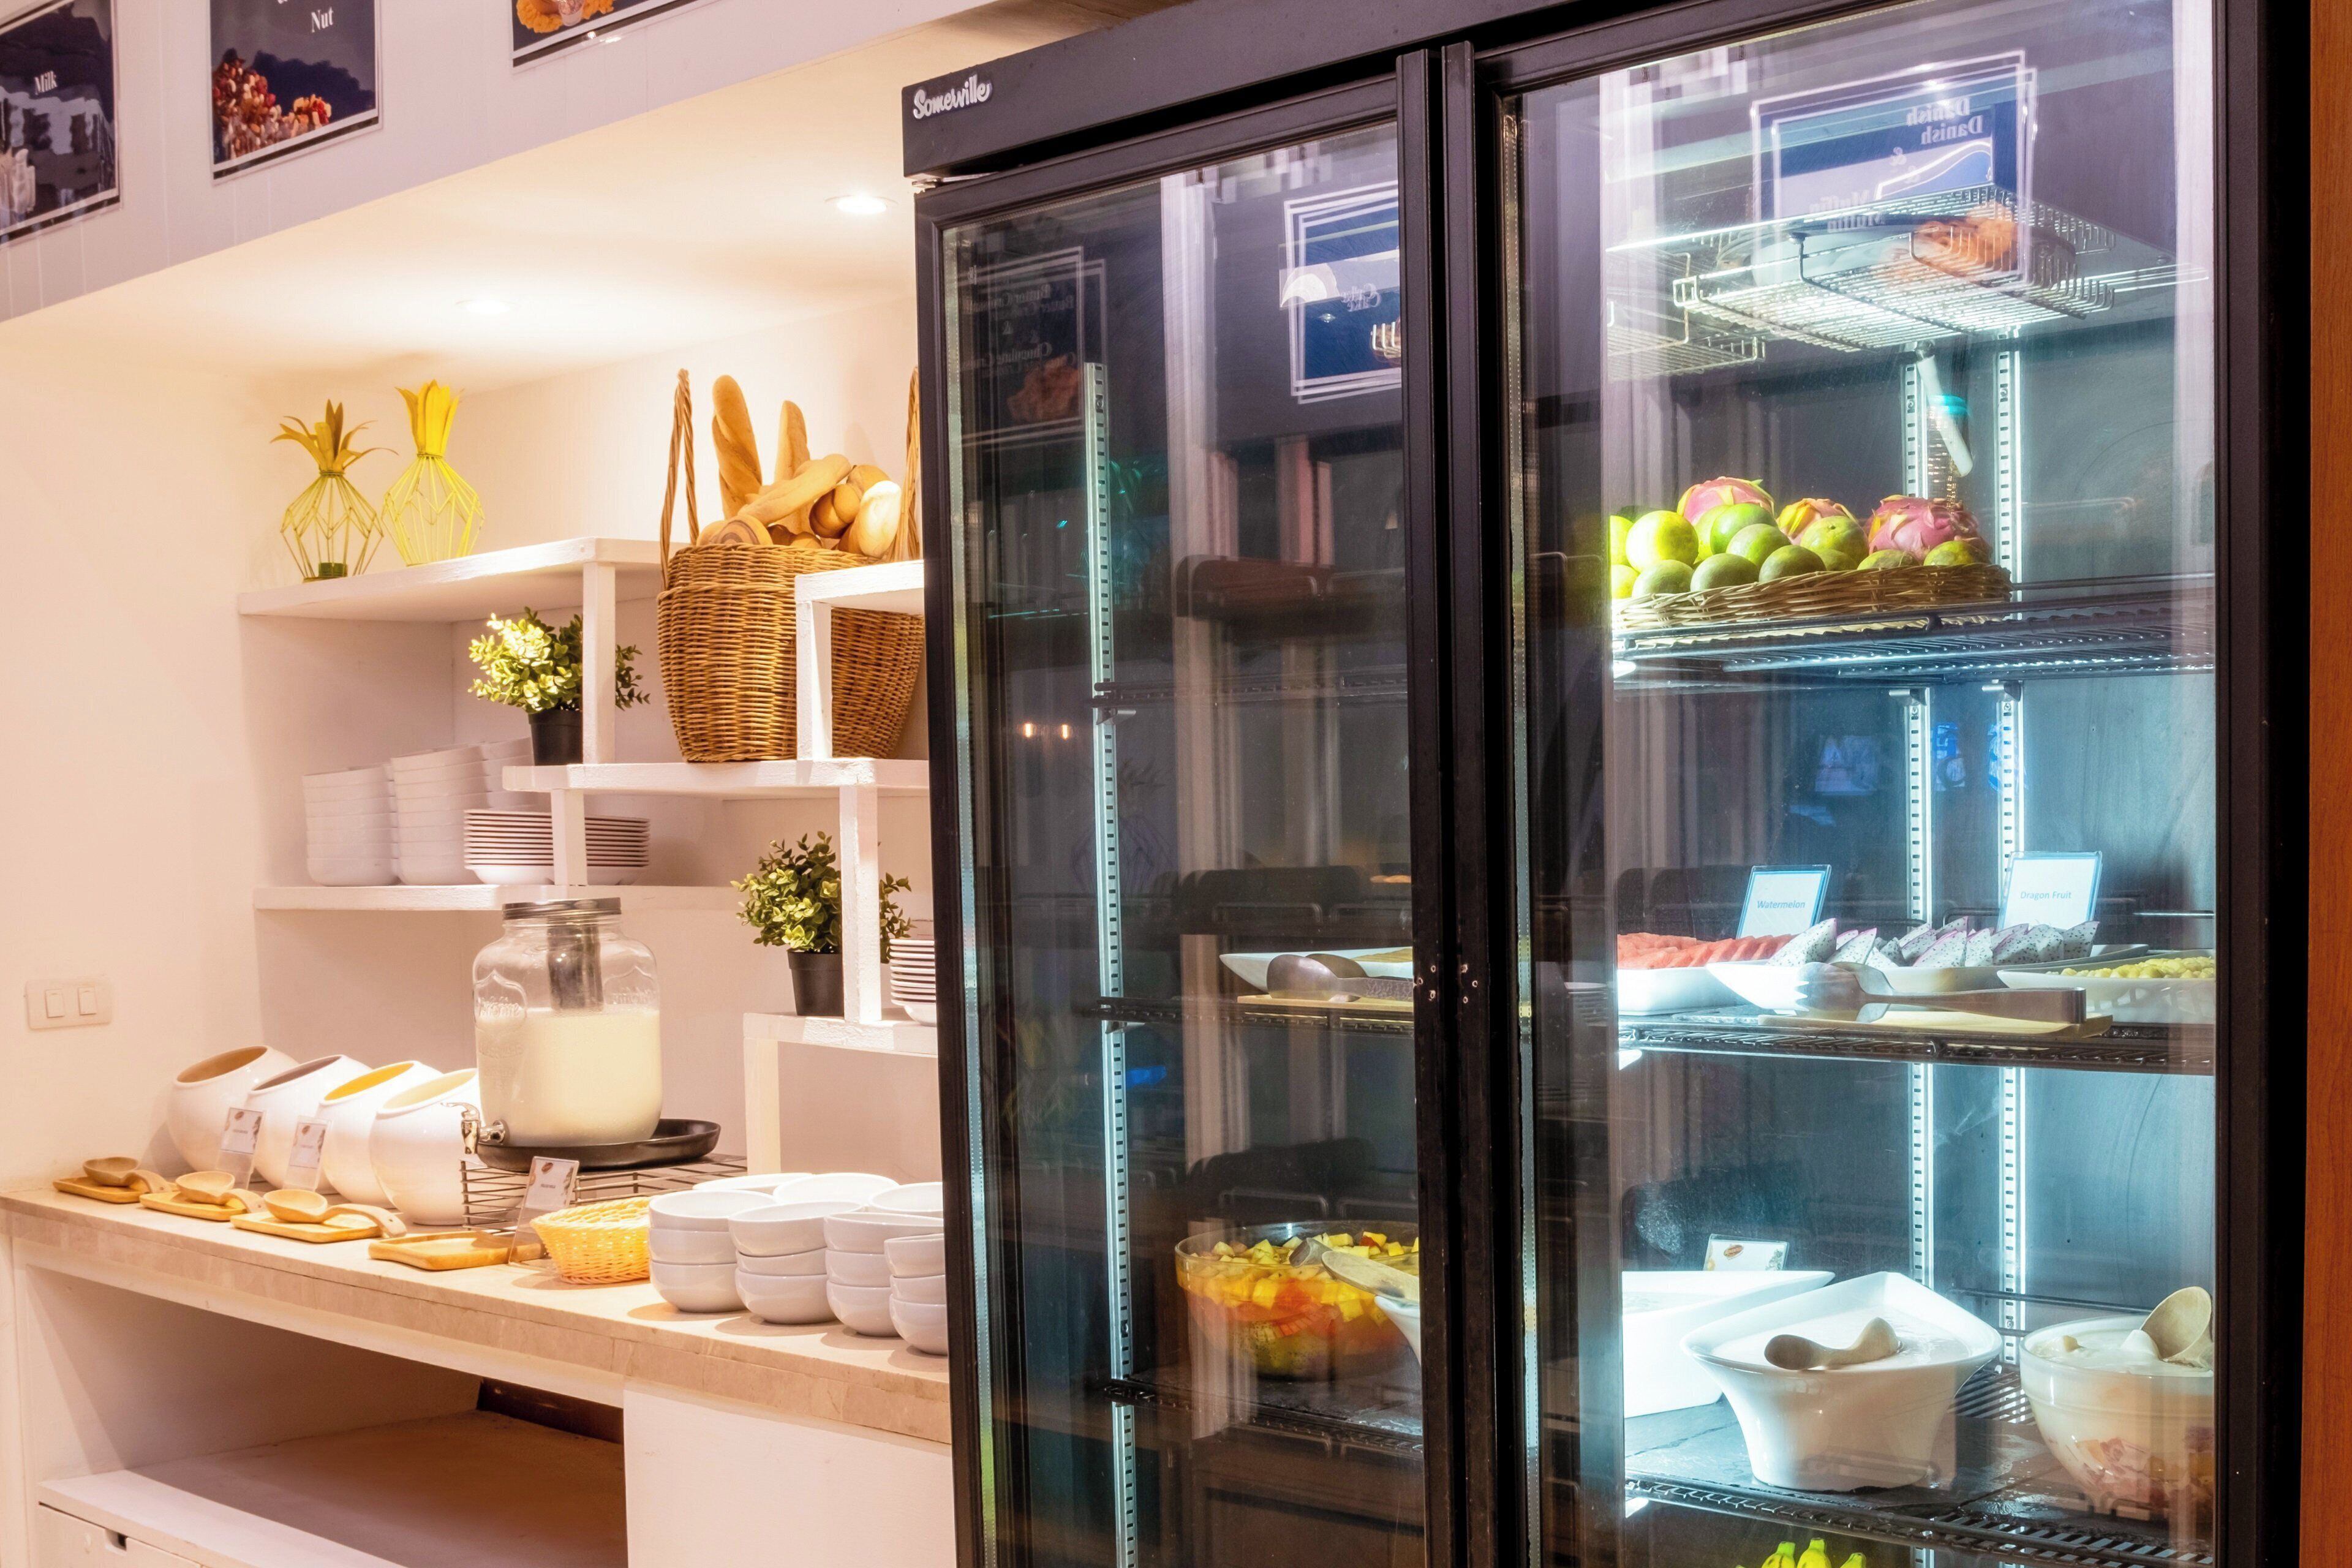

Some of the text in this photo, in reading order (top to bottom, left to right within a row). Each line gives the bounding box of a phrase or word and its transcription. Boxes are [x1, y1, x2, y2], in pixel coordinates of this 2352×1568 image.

[311, 7, 334, 33] Nut
[34, 70, 58, 96] Milk
[913, 73, 992, 120] Somerville
[1757, 900, 1806, 909] Watermelon
[2020, 891, 2071, 901] Dragon Fruit
